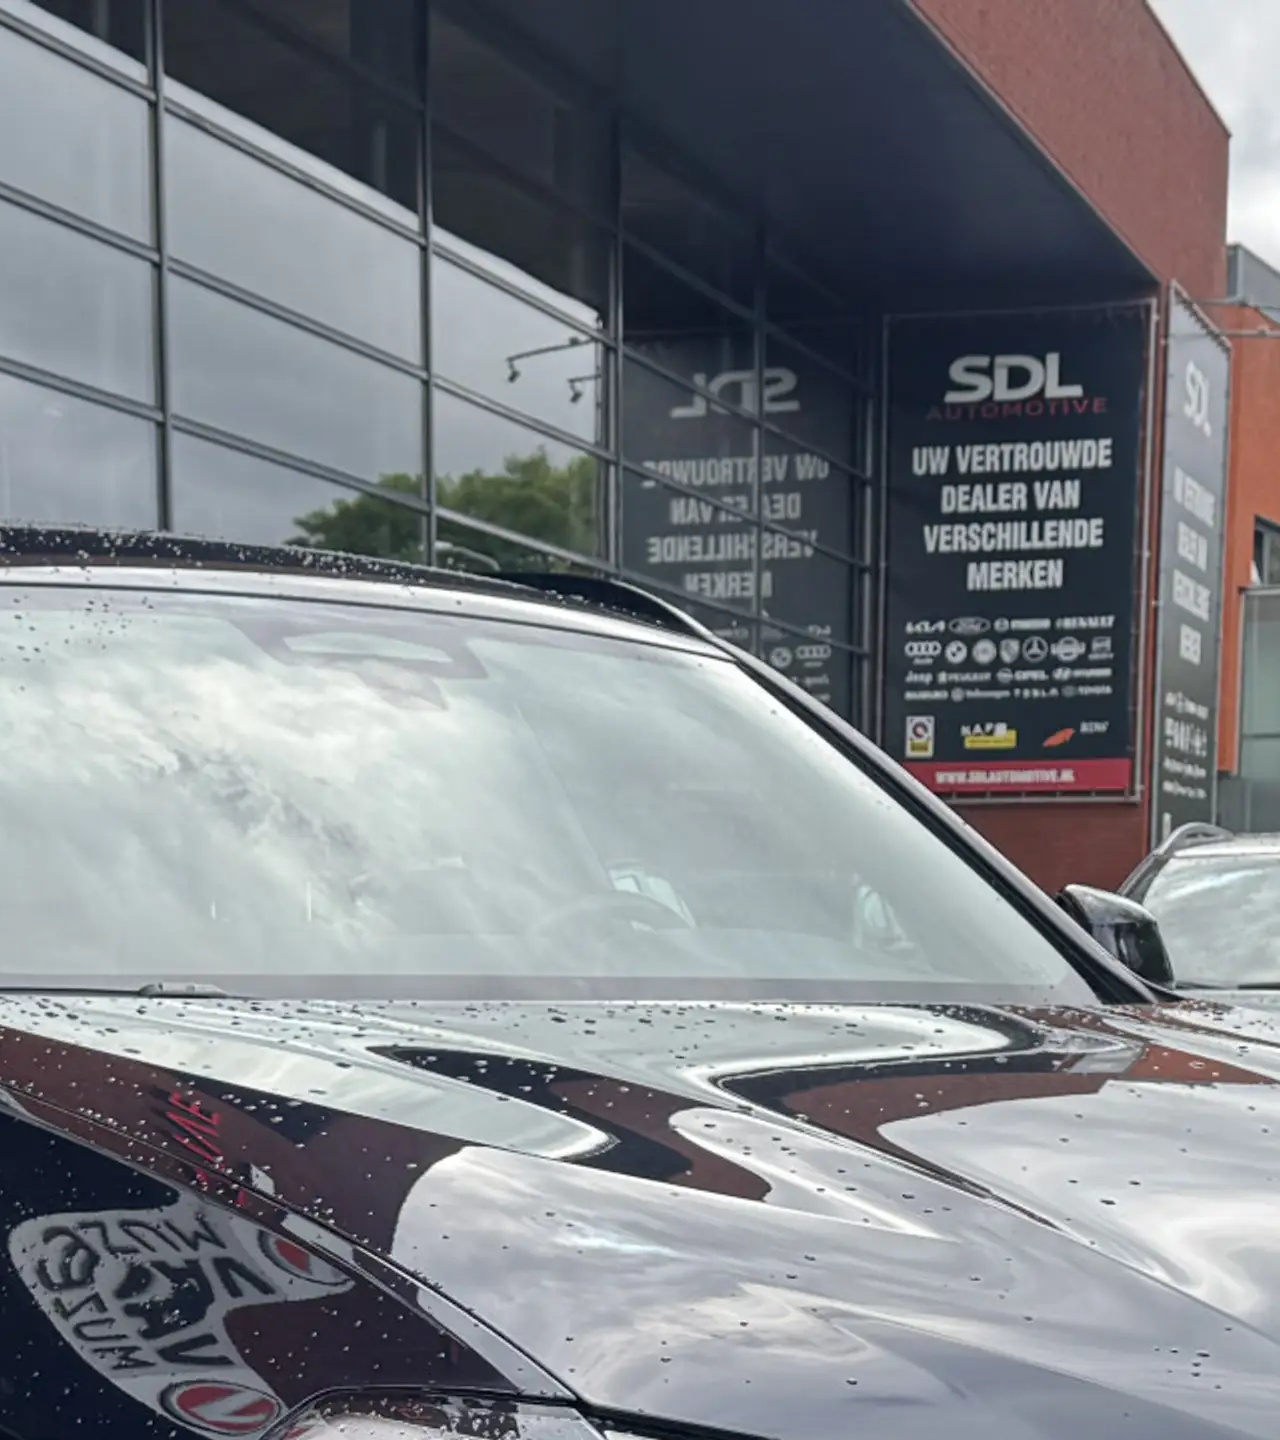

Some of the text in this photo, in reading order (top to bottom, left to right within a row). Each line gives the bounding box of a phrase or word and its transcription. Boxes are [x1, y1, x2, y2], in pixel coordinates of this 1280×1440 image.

[944, 352, 1083, 403] SDL
[925, 397, 1108, 421] AUTOMOTIVE
[912, 438, 1112, 476] UW VERTROUWDE
[941, 480, 1080, 514] DEALER VAN
[924, 519, 1103, 552] VERSCHILLENDE
[967, 559, 1063, 590] MERKEN
